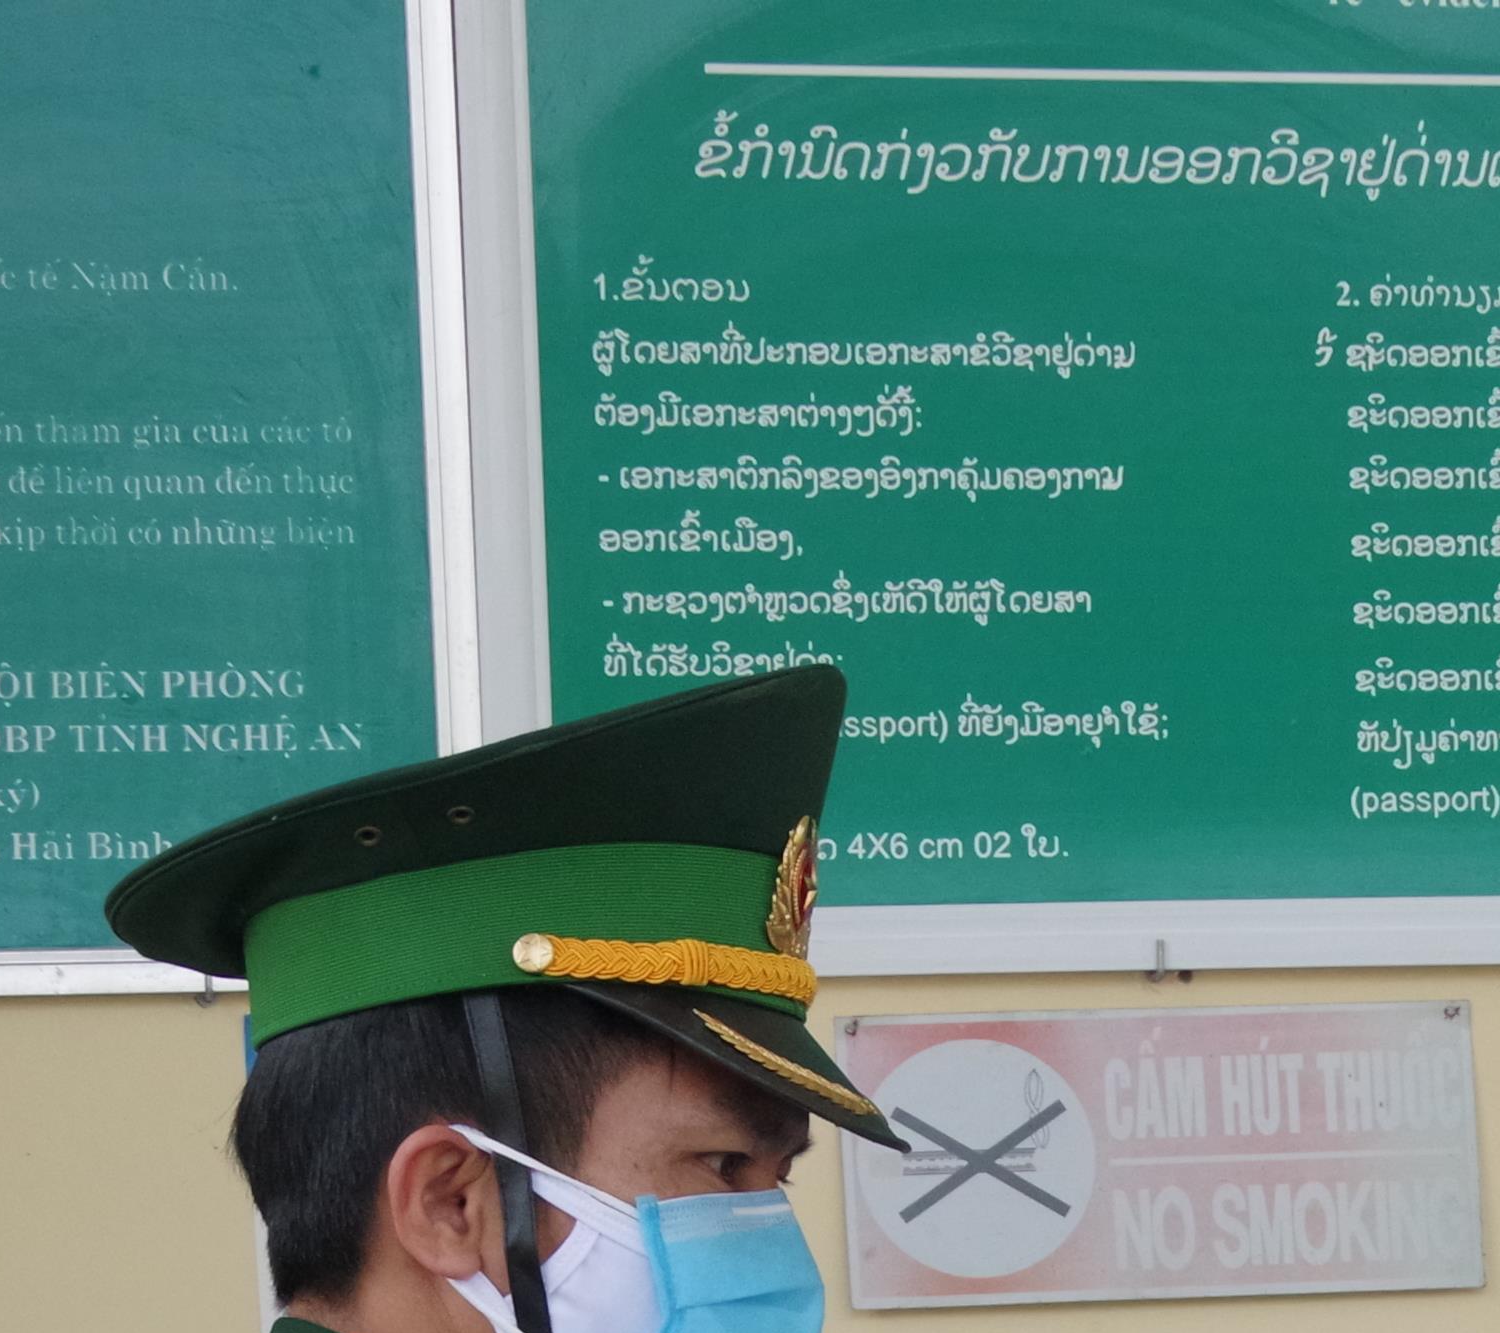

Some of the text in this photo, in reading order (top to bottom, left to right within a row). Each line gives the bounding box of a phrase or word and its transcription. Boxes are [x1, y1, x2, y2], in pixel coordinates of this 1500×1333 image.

[51, 662, 146, 698] BIÊN
[163, 662, 303, 698] PHÒNG
[69, 722, 167, 752] TỈNH
[182, 715, 297, 758] NGHỆ
[310, 723, 361, 750] AN
[839, 710, 948, 743] ssport)
[1351, 785, 1500, 818] (passport)
[12, 832, 73, 860] Hải
[847, 832, 908, 859] 4X6
[919, 838, 963, 859] cm
[974, 831, 1011, 858] 02
[1105, 1026, 1466, 1141] CẤM HÚT THUỐC
[1112, 1178, 1466, 1270] NO SMOKING
